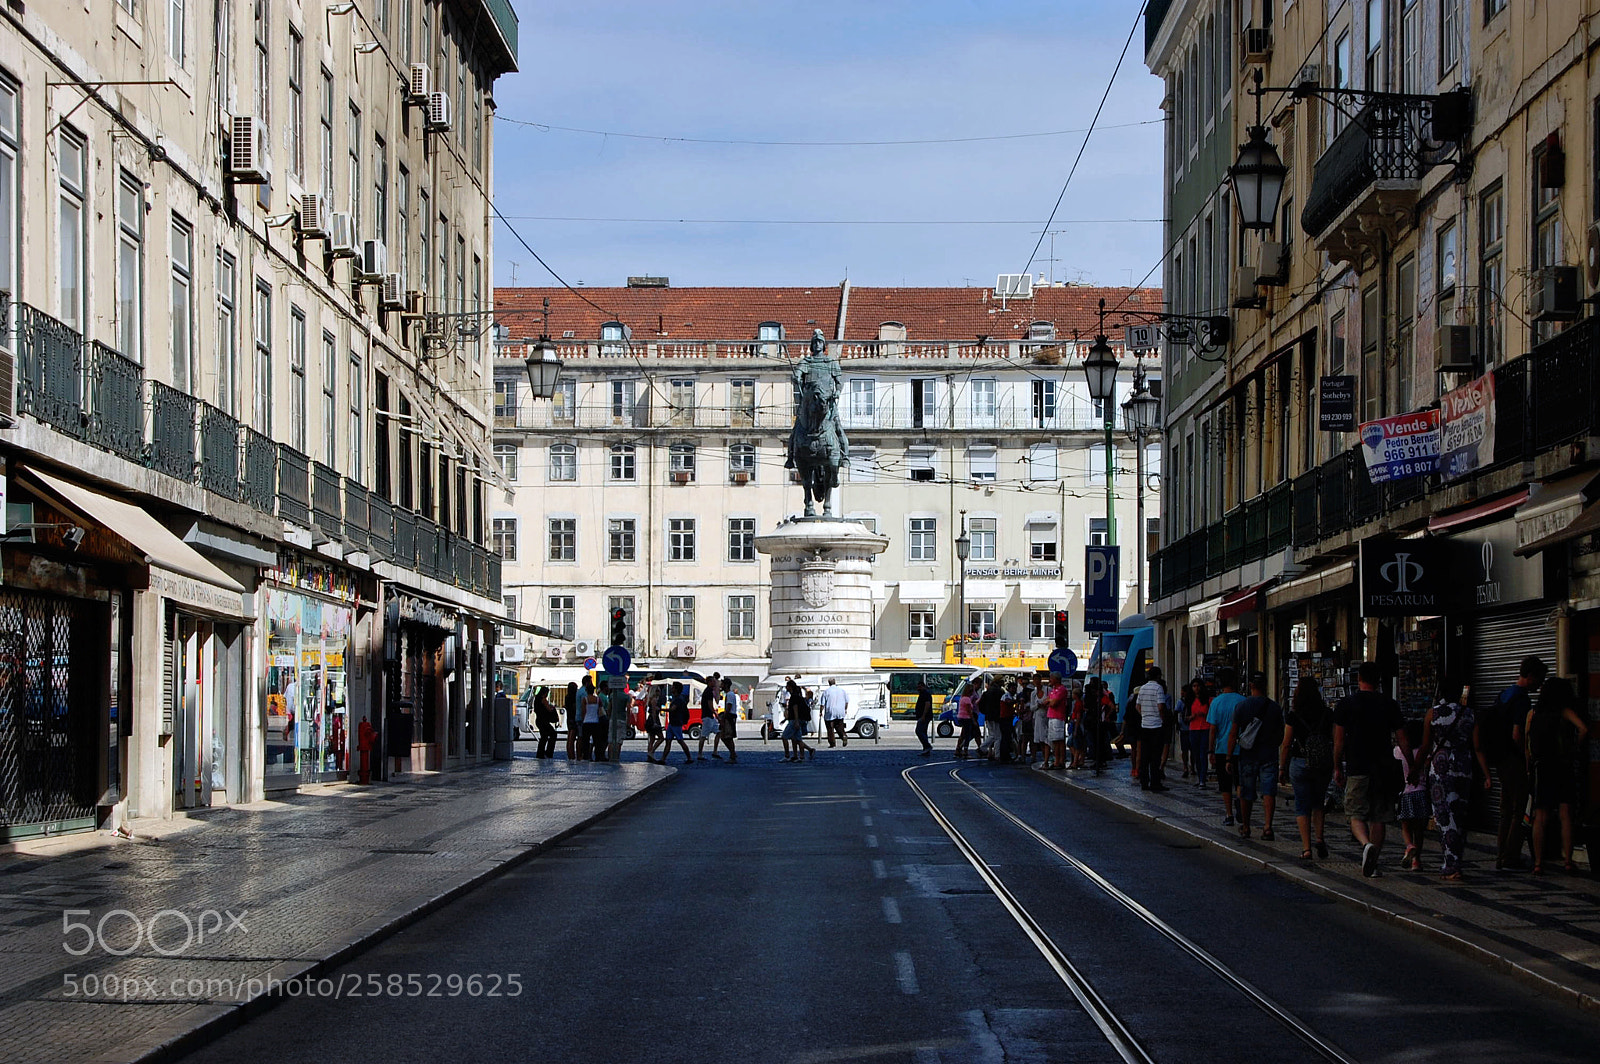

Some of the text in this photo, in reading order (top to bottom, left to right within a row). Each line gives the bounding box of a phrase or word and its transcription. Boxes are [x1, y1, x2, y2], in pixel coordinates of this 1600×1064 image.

[1134, 329, 1147, 341] 10
[1322, 380, 1345, 388] Portugal
[1322, 392, 1351, 400] Sotheby's
[1385, 419, 1428, 436] Vende
[1385, 437, 1409, 449] Pedro
[1384, 448, 1405, 462] 966
[1408, 445, 1428, 458] 911
[1392, 463, 1412, 476] 218
[1414, 461, 1432, 472] 807
[966, 567, 1061, 576] PENSÃO BEIRA MINHO
[1088, 552, 1107, 596] P
[1370, 594, 1435, 606] PESARUM
[795, 615, 815, 623] DOM
[819, 613, 843, 622] JOÃO
